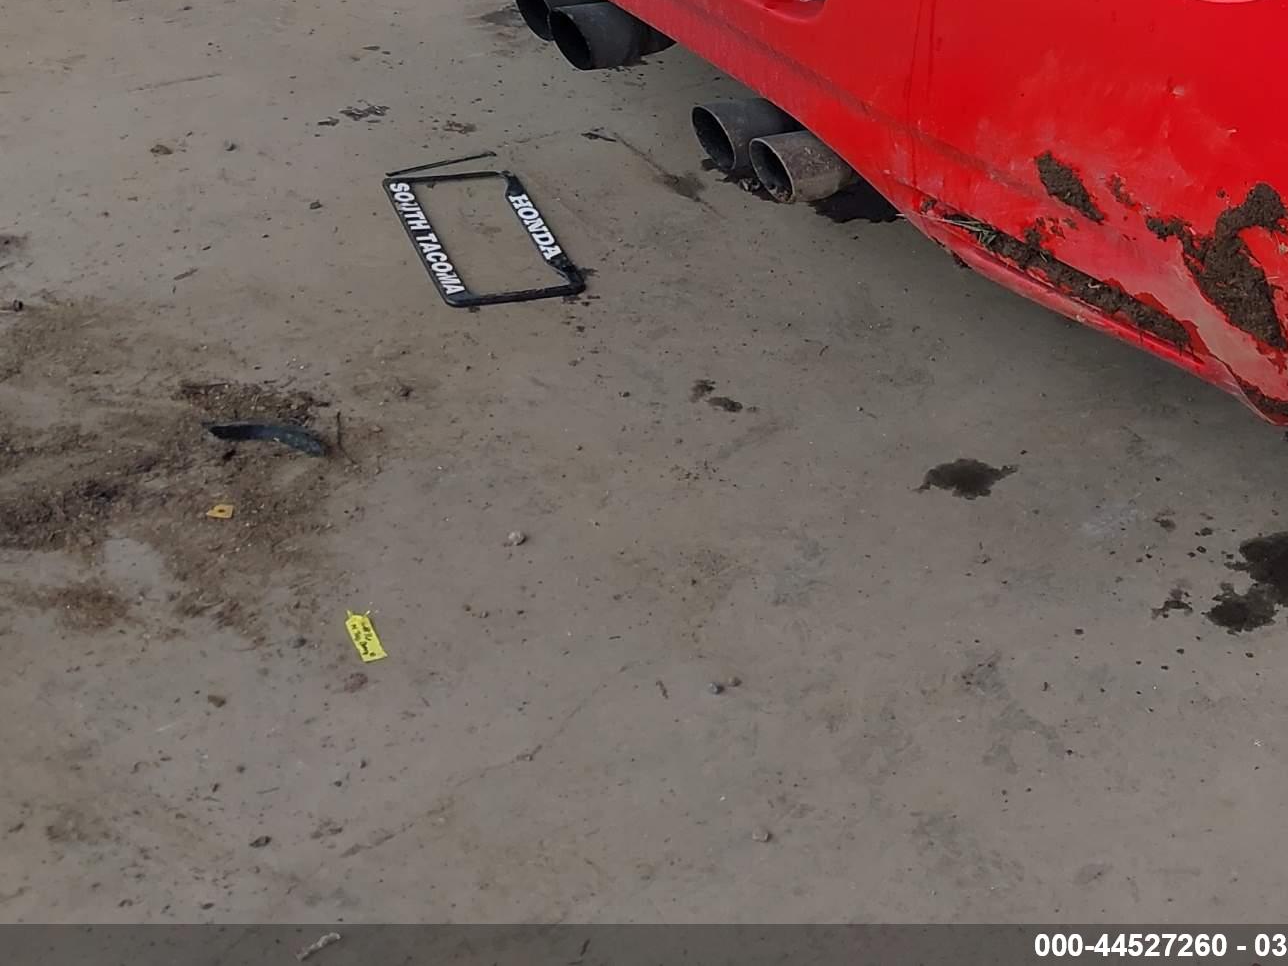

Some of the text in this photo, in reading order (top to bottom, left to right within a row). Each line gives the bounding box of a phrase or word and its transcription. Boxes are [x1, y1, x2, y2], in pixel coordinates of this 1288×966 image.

[389, 182, 465, 295] SOUTH TACOMA
[509, 193, 561, 260] HONDA
